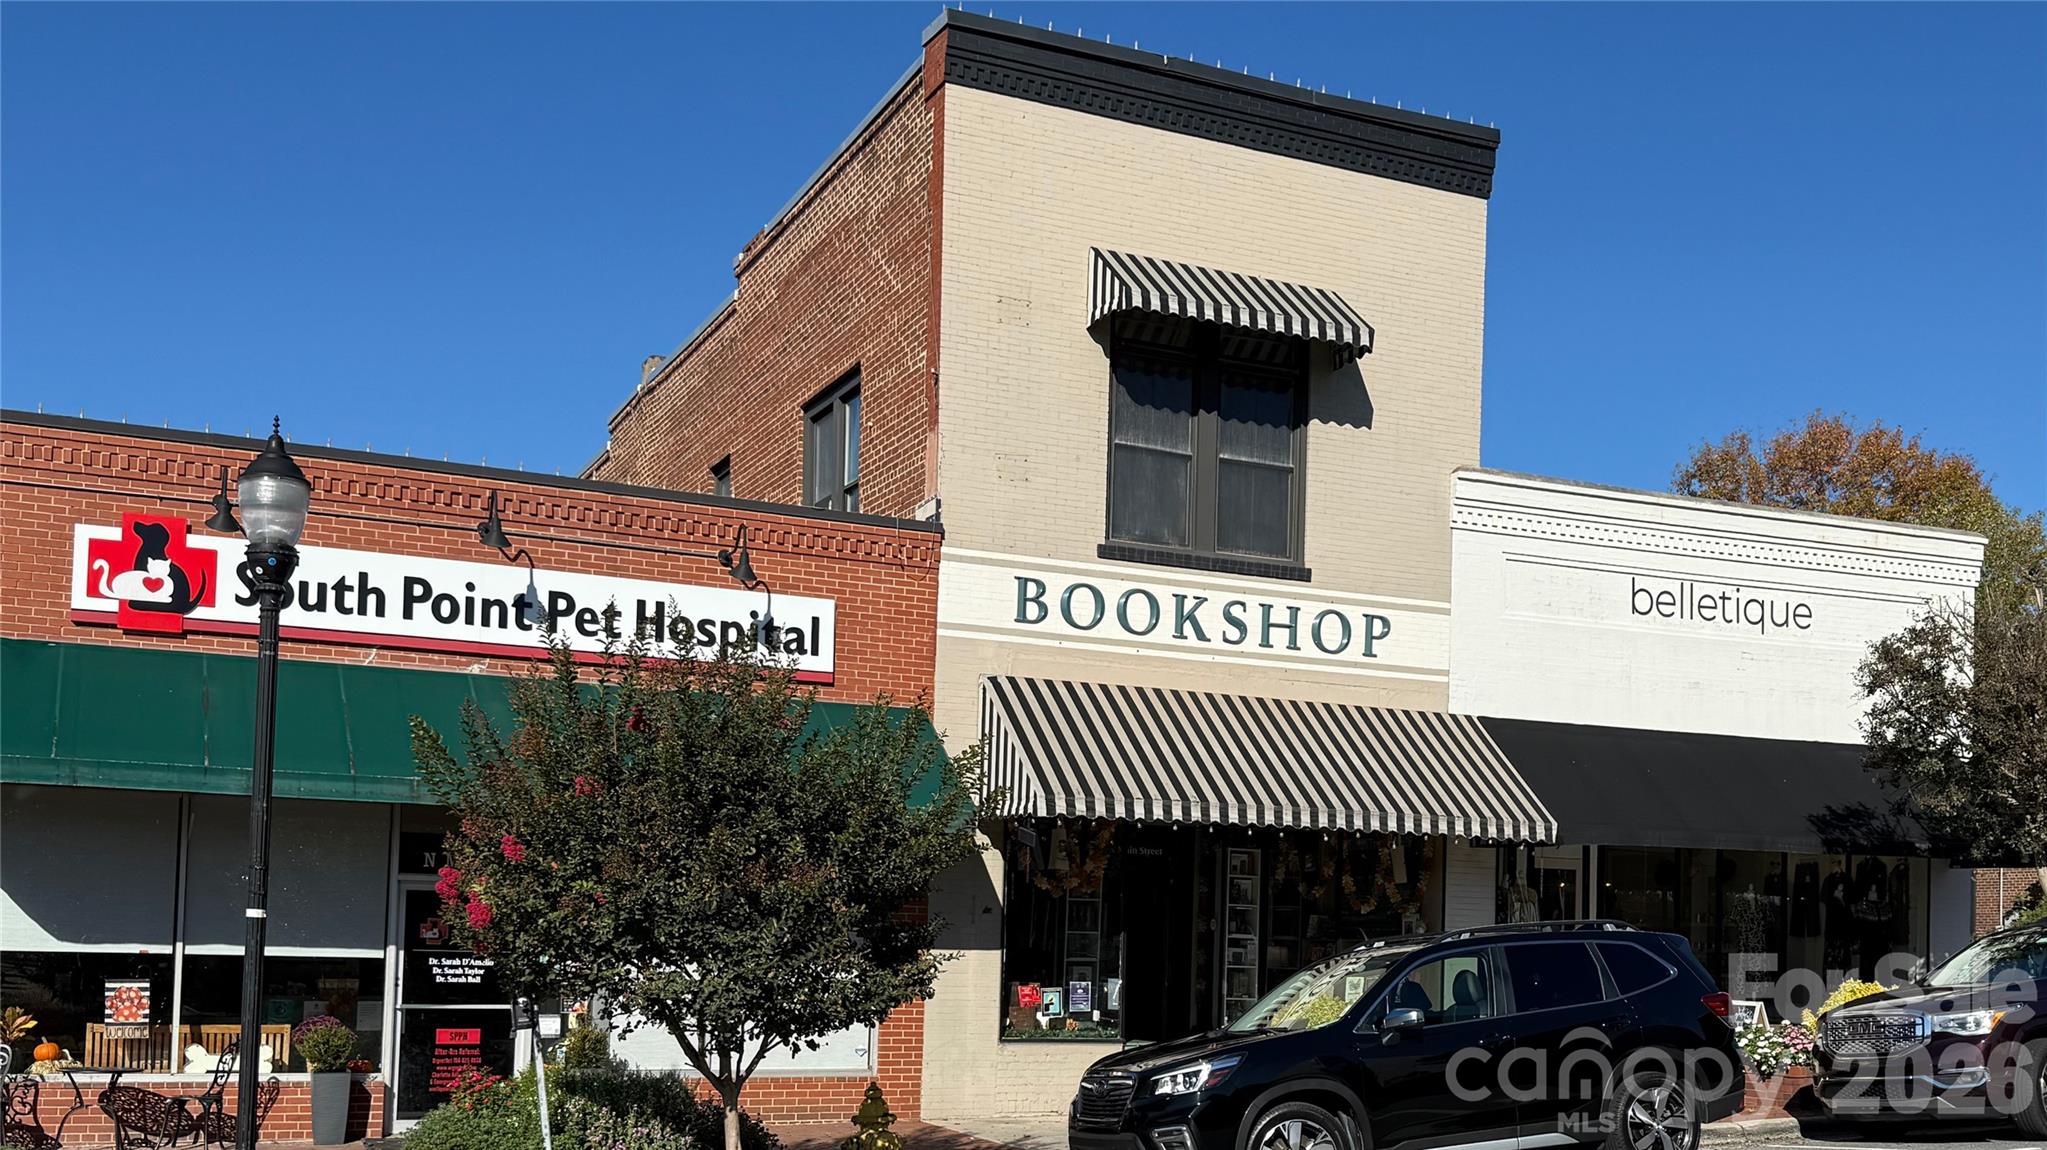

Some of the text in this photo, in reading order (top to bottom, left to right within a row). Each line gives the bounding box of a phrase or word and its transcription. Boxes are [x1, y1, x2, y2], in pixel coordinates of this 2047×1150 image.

[402, 575, 533, 632] Point
[548, 590, 622, 639] Pet
[636, 598, 821, 658] Hospital
[1013, 575, 1392, 658] BOOKSHOP
[1631, 576, 1813, 636] belletique
[428, 957, 440, 965] Dr.
[441, 957, 461, 966] Sarah
[432, 966, 485, 976] Dr. Sarah Taylor
[435, 975, 446, 983] Dr.
[447, 975, 466, 983] Sarah
